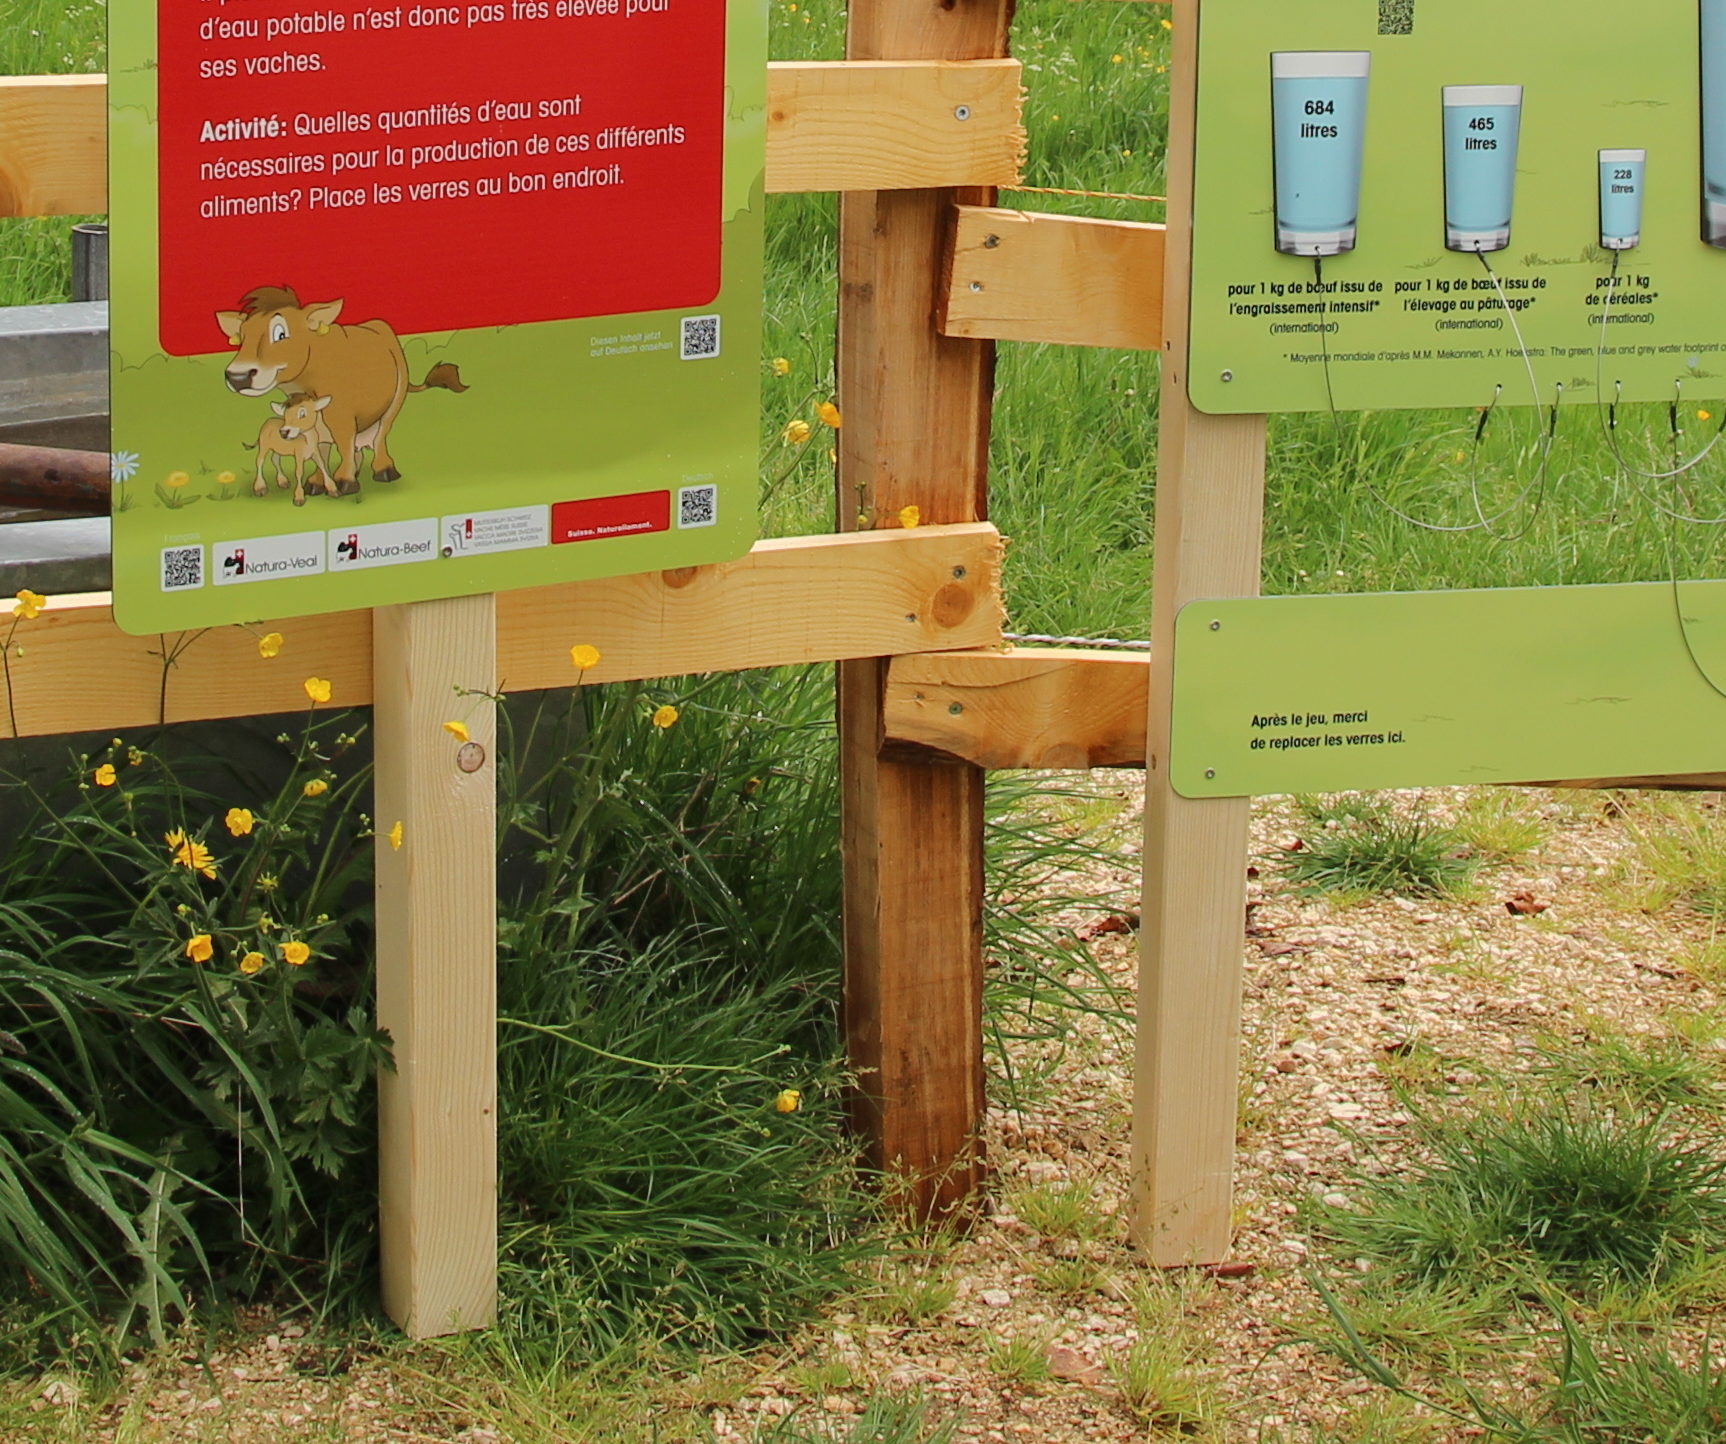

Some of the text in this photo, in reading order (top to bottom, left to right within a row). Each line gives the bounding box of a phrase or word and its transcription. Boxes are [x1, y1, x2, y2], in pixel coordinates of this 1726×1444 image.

[1304, 99, 1335, 116] 684
[199, 93, 582, 143] Activité: Quelles quantités d'eau sont
[1468, 117, 1495, 131] 465
[1300, 123, 1338, 138] litres
[200, 123, 685, 181] nécessaires pour la production de ces différents
[1465, 137, 1498, 151] litres
[1613, 169, 1633, 180] 228
[200, 163, 625, 218] aliments? Place les verres au bon endroit.
[1611, 183, 1635, 194] litres
[1227, 284, 1256, 298] pour
[1260, 282, 1265, 295] 1
[1270, 281, 1285, 297] kg
[1287, 281, 1303, 294] de
[1340, 280, 1365, 293] issu
[1368, 280, 1384, 292] de
[1394, 278, 1468, 295] pour 1 kg de
[1504, 276, 1547, 290] issu de
[1459, 299, 1475, 310] au
[1434, 317, 1504, 332] (international)
[358, 539, 432, 561] Natura-Beef
[245, 554, 318, 575] Natura-Veal
[1251, 710, 1368, 730] Après le jeu, merci
[1250, 730, 1406, 752] de replacer les verres ici.
